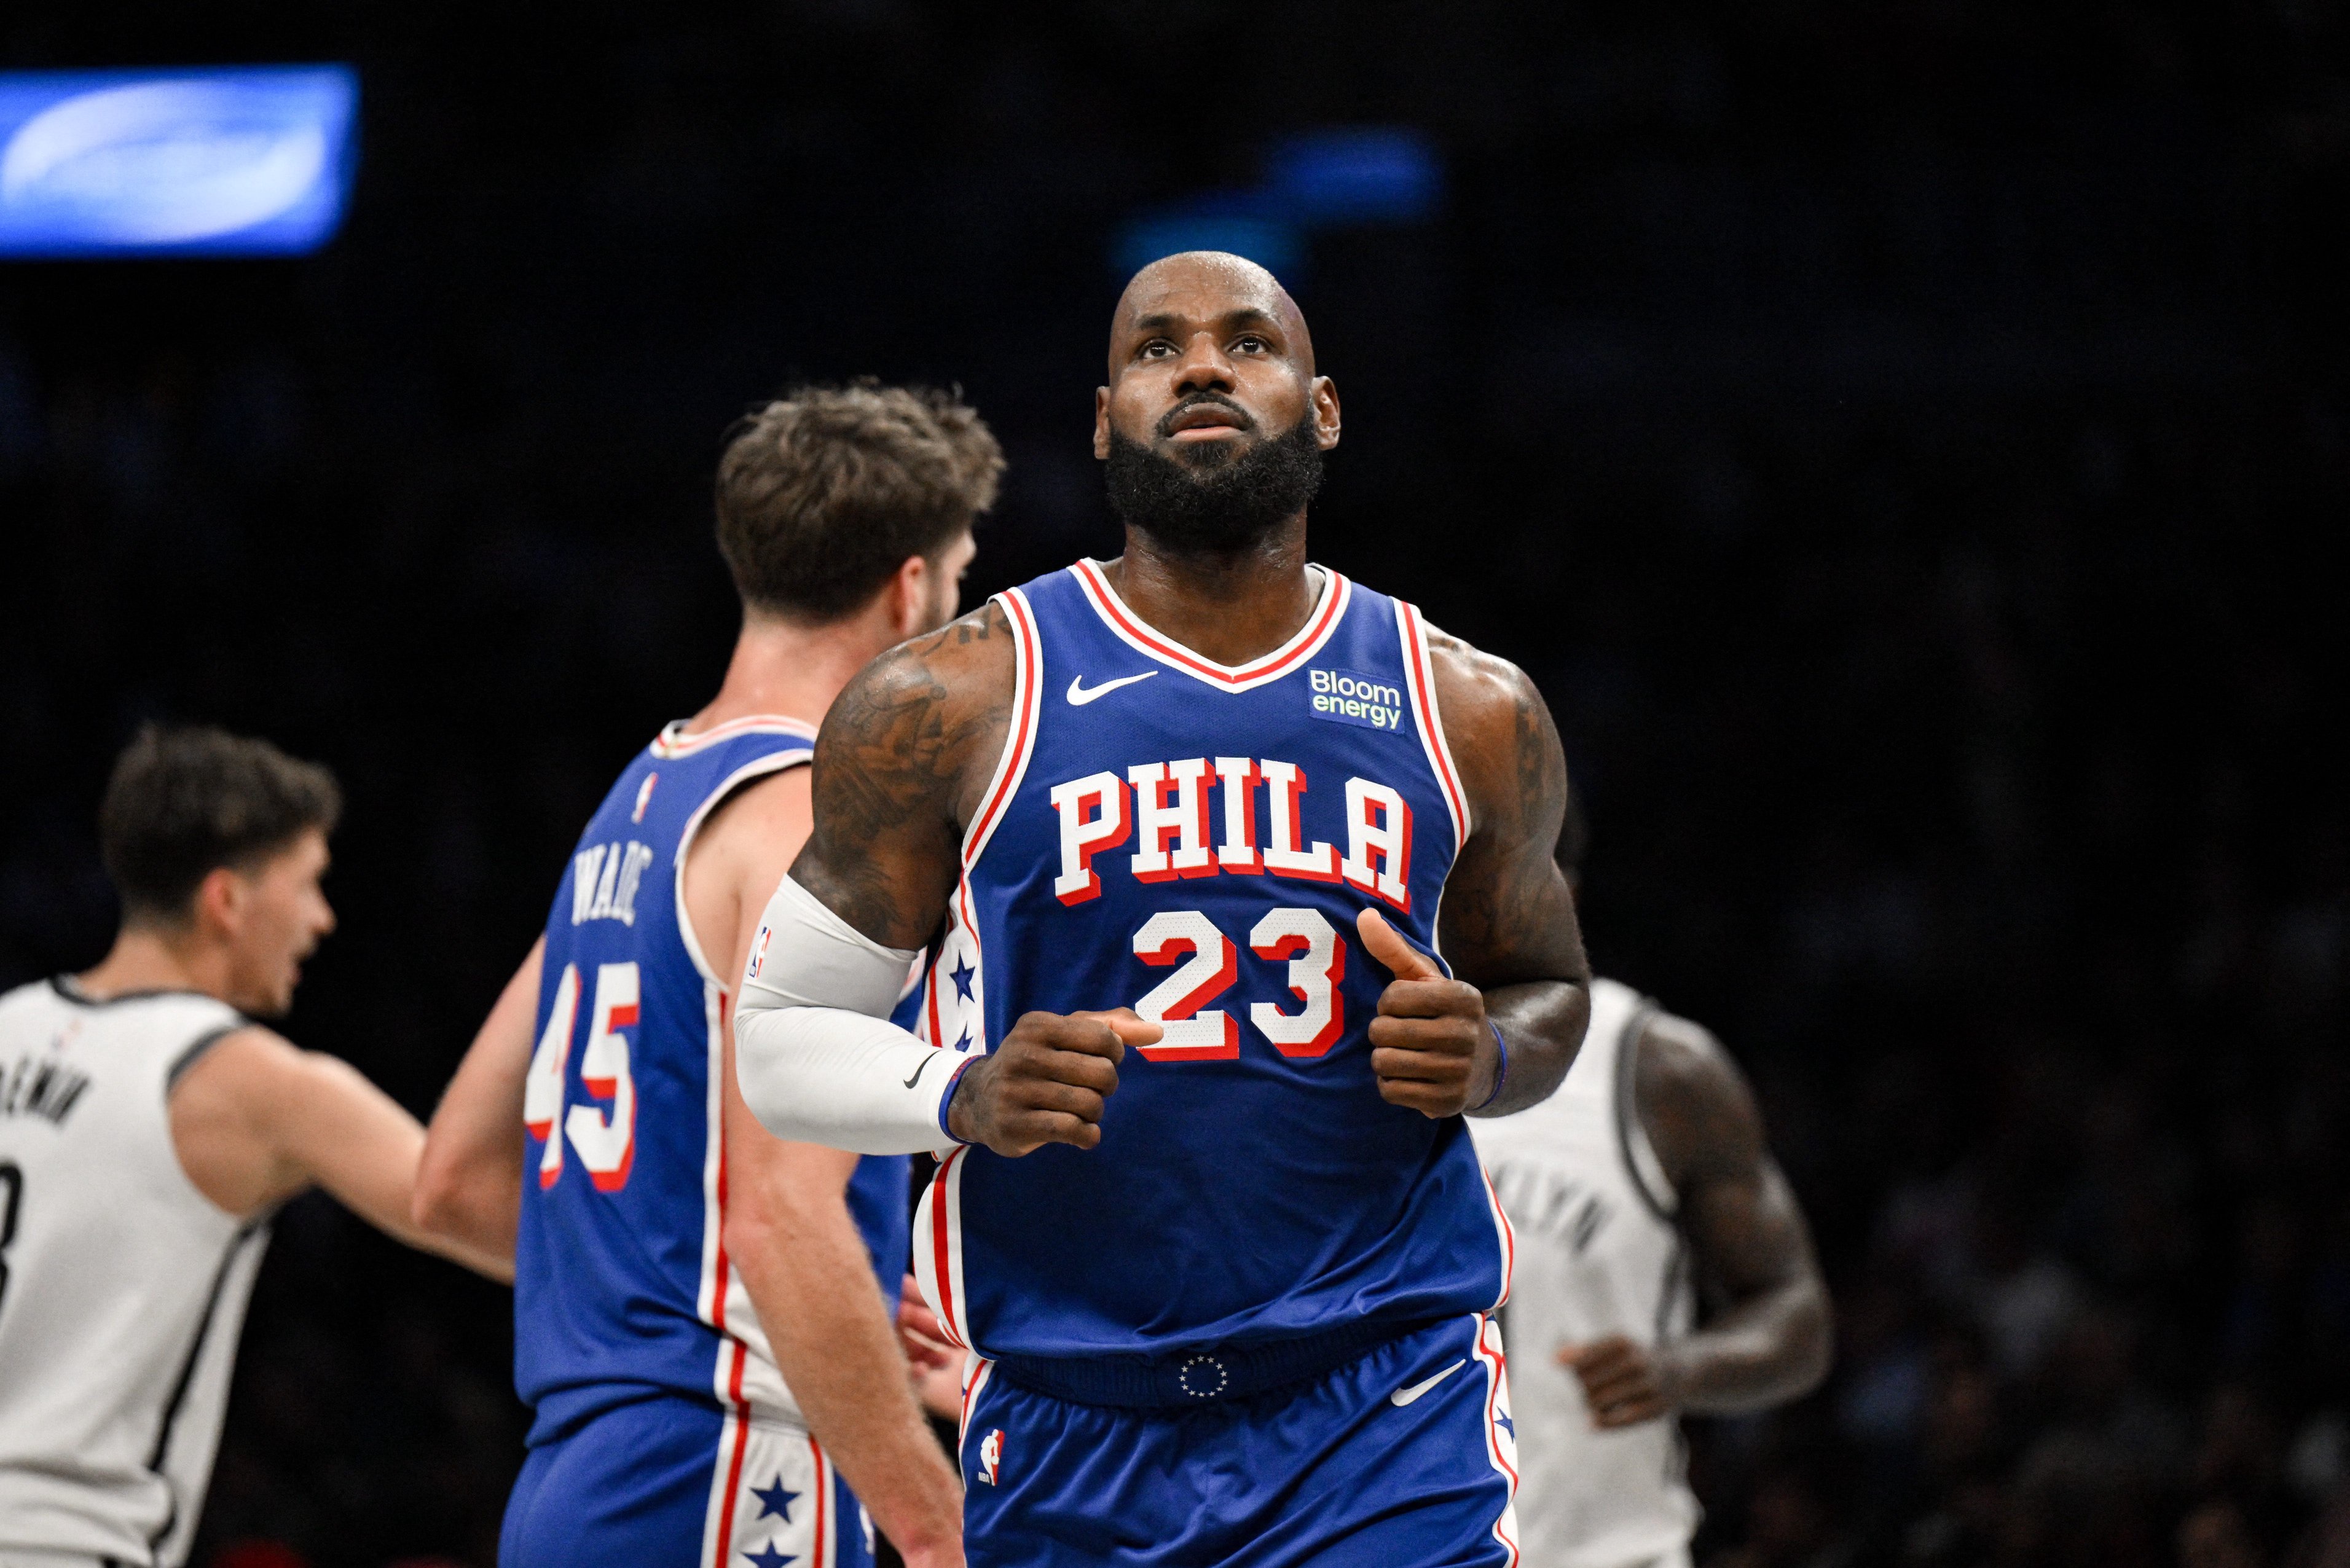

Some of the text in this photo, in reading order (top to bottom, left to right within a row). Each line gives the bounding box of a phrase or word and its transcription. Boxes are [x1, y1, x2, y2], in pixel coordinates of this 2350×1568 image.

[1310, 670, 1401, 707] Bloom
[1313, 695, 1401, 730] energy
[1050, 757, 1413, 915] PHILA
[1133, 908, 1346, 1062] 23
[524, 961, 640, 1192] 45
[978, 1472, 990, 1484] NBA
